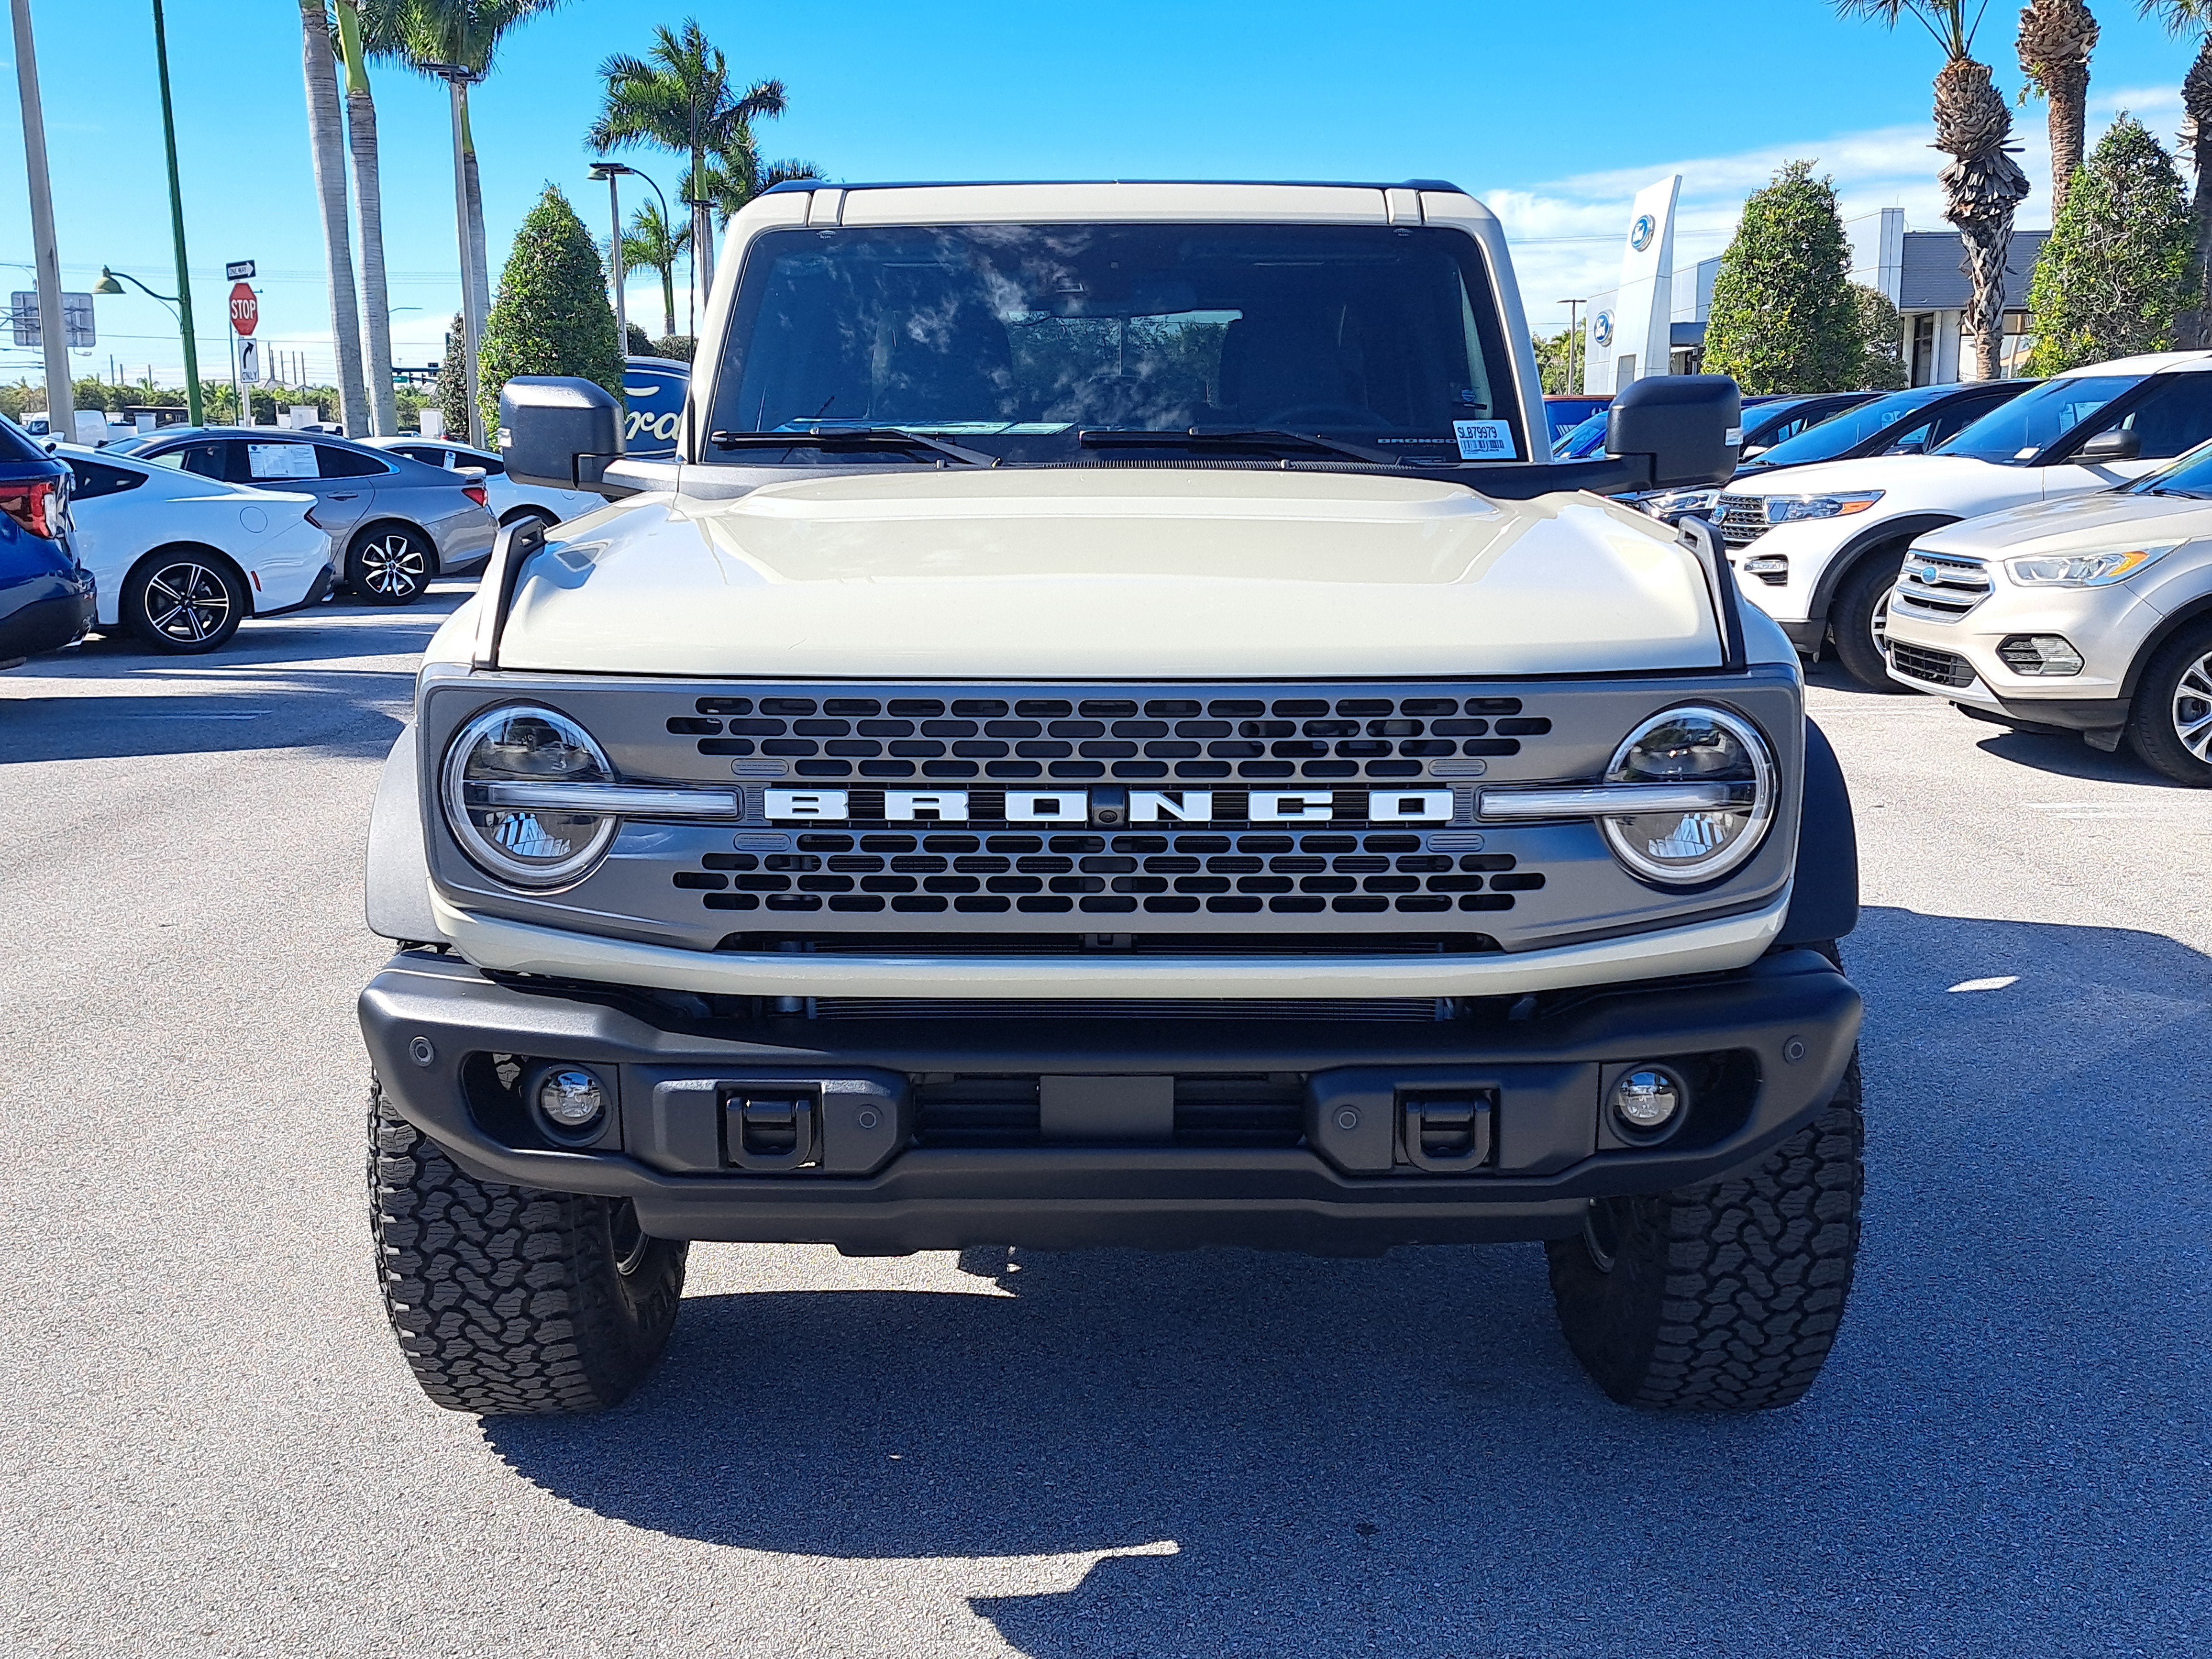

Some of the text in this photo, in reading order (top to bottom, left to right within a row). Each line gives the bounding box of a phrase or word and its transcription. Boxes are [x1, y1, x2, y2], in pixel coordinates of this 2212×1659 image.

[231, 299, 256, 320] STOP
[242, 372, 257, 381] ONLY
[1457, 426, 1497, 439] SLB79979
[764, 789, 1453, 821] BRONCO
